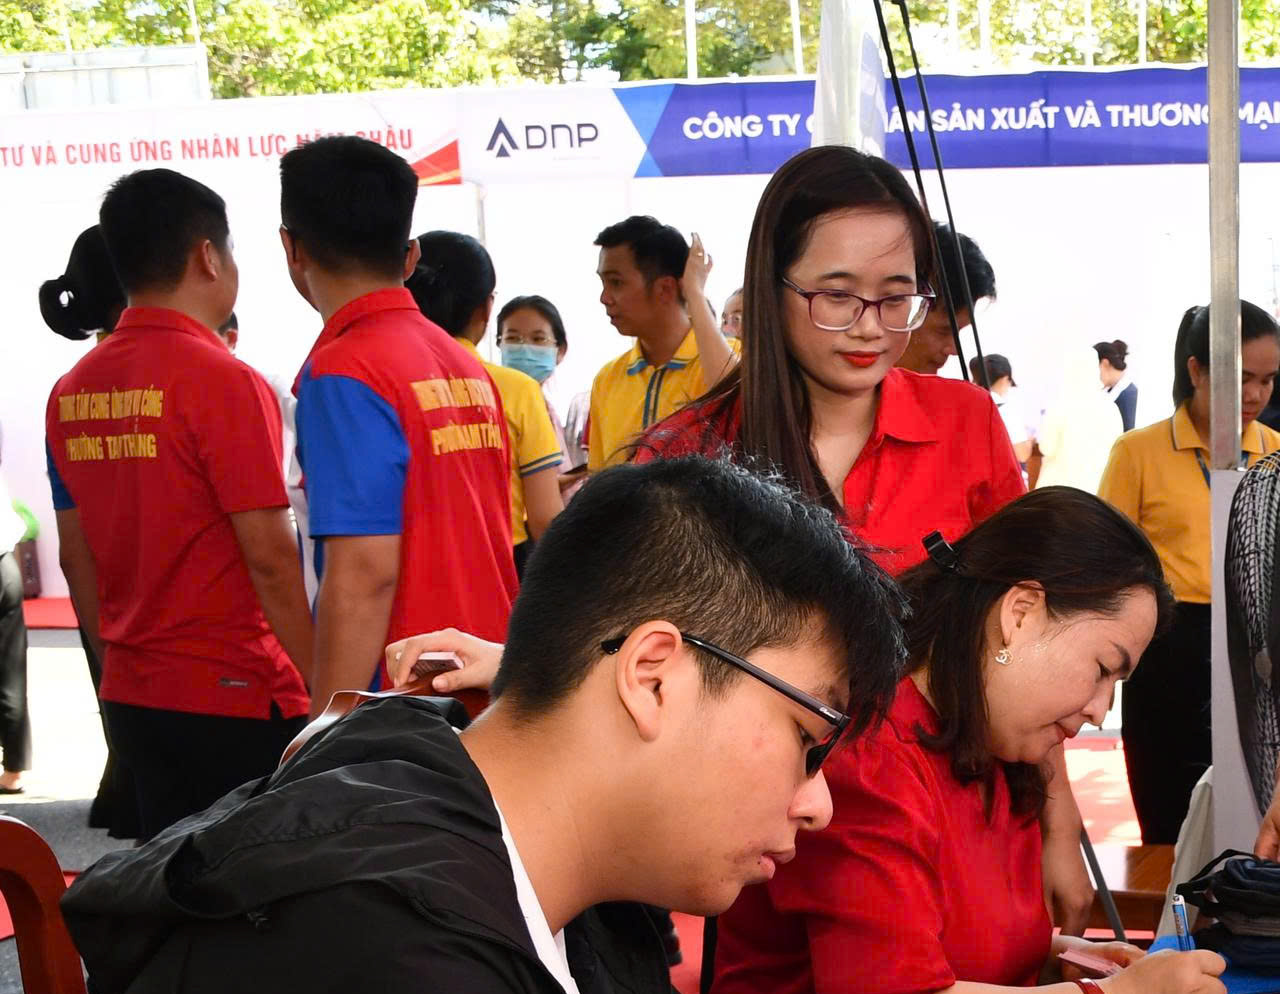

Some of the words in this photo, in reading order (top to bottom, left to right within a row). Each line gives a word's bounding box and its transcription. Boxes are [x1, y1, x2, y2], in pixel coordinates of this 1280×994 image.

[682, 110, 764, 140] CÔNG
[767, 114, 801, 136] TY
[930, 102, 985, 132] SẢN
[991, 98, 1060, 130] XUẤT
[1064, 100, 1101, 127] VÀ
[31, 141, 57, 165] VÀ
[65, 142, 121, 165] CUNG
[130, 137, 172, 162] ỨNG
[180, 133, 240, 160] NHÂN
[248, 133, 288, 161] LỰC
